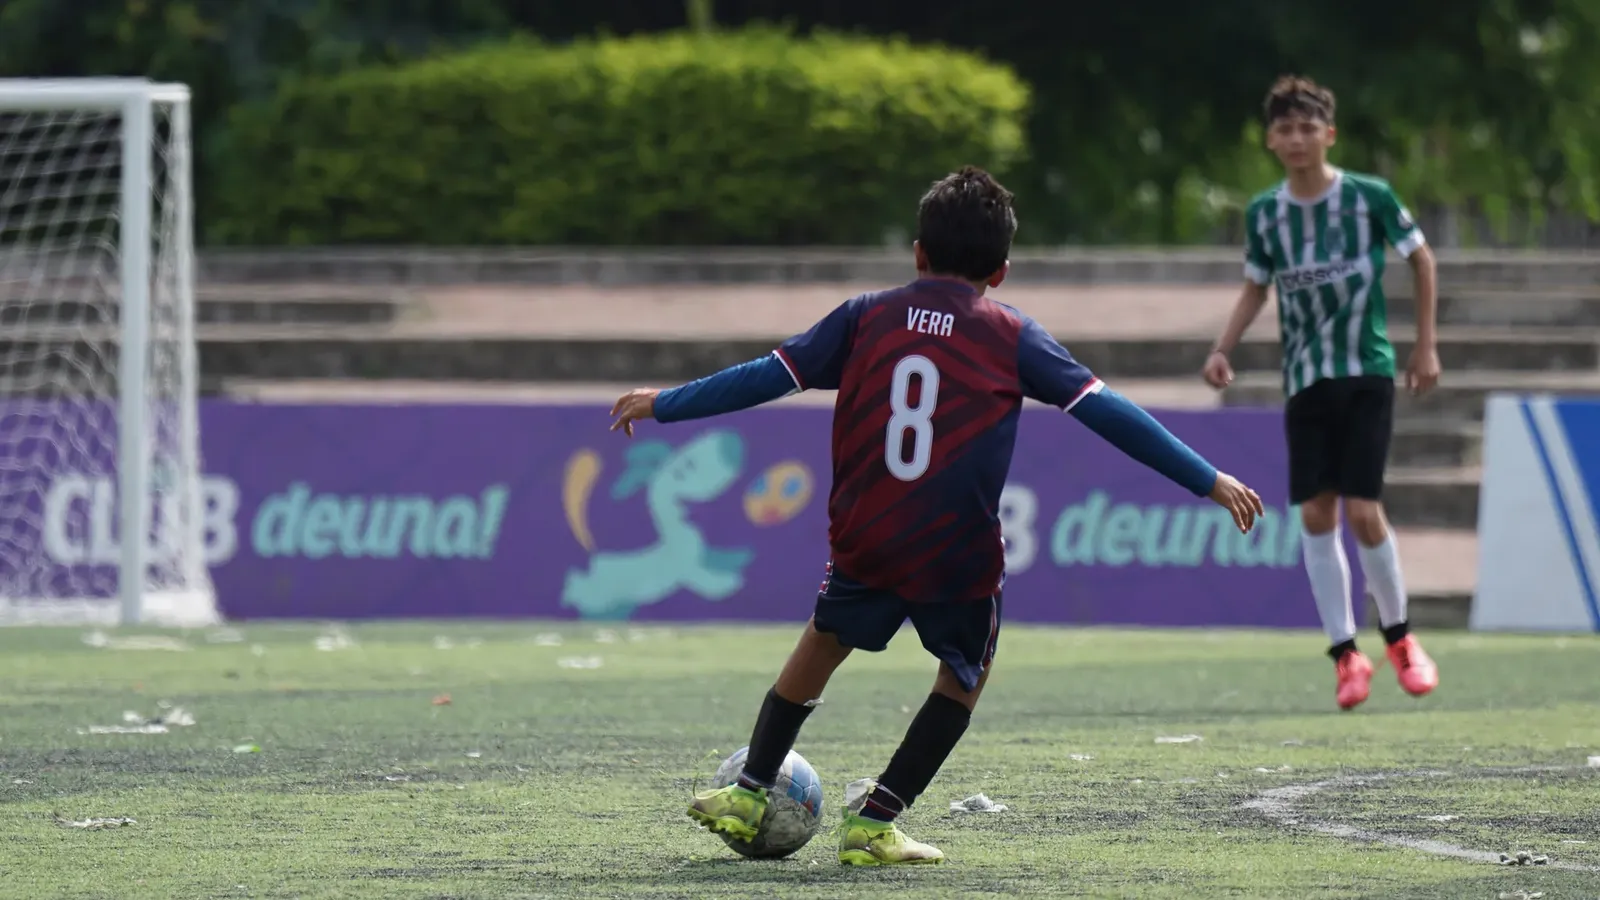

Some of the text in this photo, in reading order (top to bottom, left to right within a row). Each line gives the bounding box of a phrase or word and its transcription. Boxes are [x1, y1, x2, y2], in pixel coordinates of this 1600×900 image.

[907, 306, 954, 337] VERA
[885, 354, 940, 481] 8
[253, 482, 510, 559] deuna!
